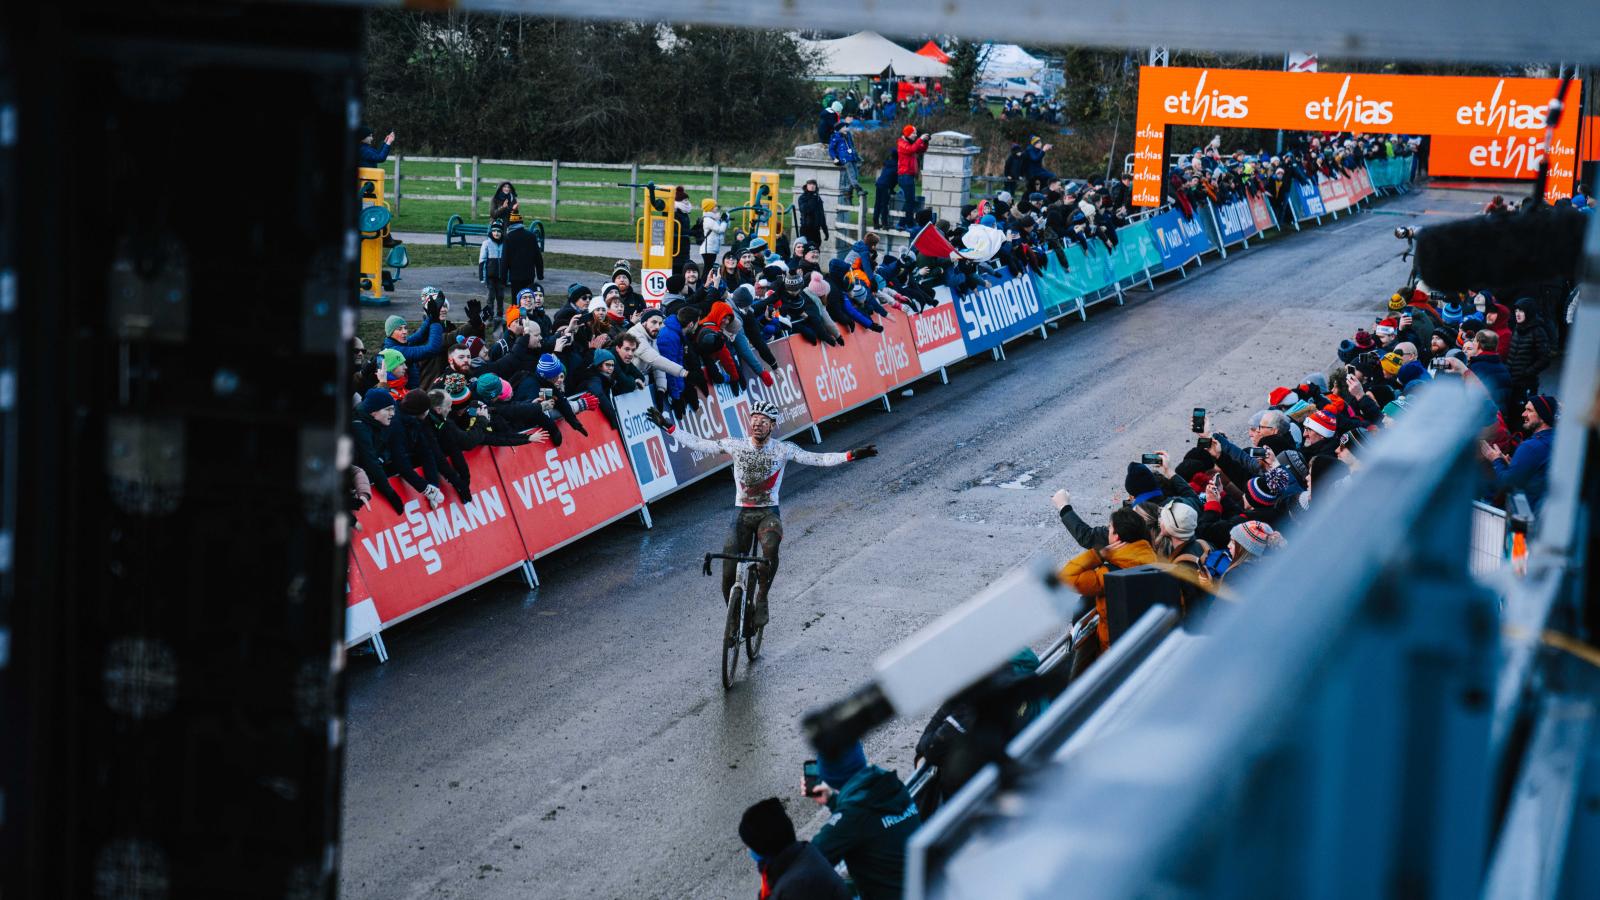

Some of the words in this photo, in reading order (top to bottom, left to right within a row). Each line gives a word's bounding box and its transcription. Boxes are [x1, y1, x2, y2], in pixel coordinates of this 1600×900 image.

[1164, 70, 1248, 123] ethias
[1305, 75, 1393, 129] ethias
[1456, 79, 1549, 134] ethias
[1135, 144, 1161, 160] ethias
[1137, 123, 1163, 139] ethias
[1133, 187, 1159, 203] ethias
[1134, 166, 1160, 182] ethias
[649, 276, 664, 289] 15
[959, 273, 1039, 341] SHIMANO
[816, 341, 858, 409] ethias
[875, 312, 909, 384] ethias
[512, 440, 624, 517] VIESSMANN
[361, 486, 506, 575] VIESSMANN
